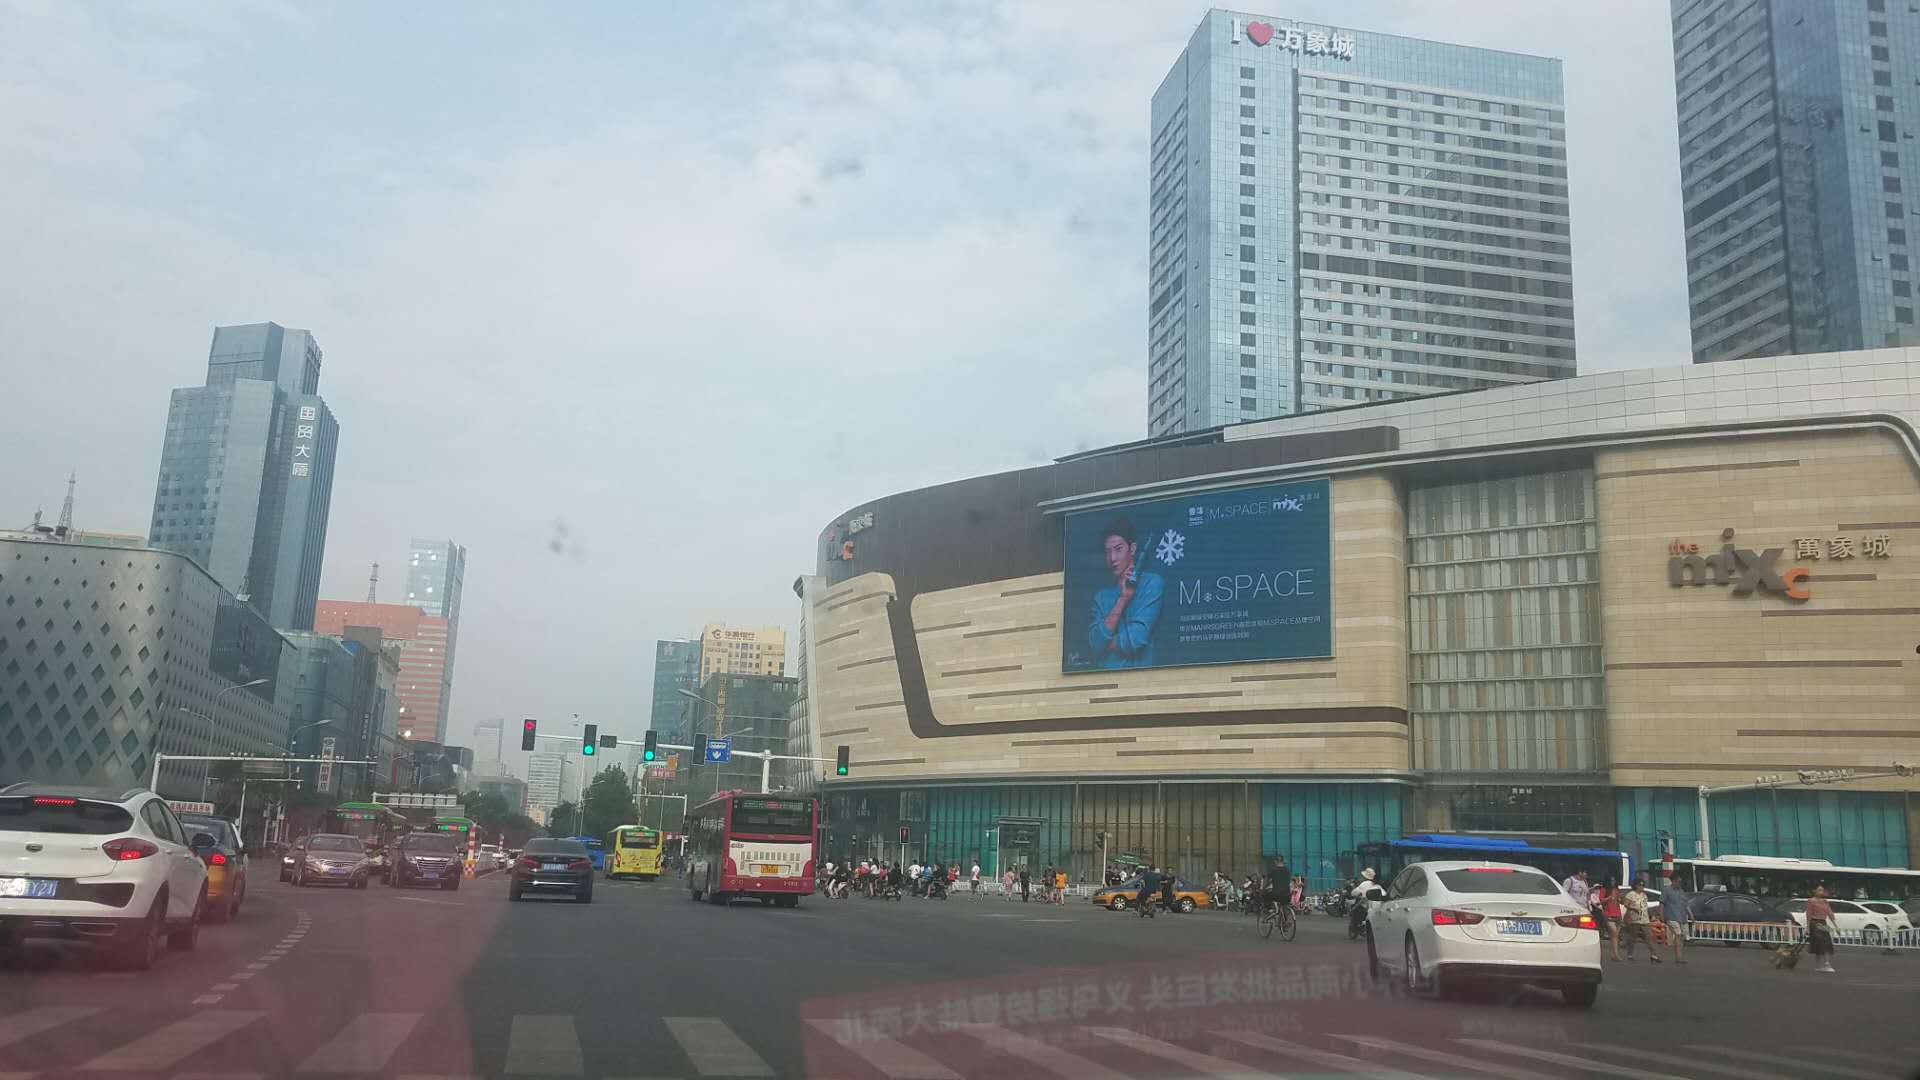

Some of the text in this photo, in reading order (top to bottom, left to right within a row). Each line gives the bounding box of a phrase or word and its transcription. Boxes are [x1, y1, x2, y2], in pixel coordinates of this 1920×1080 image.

[1278, 24, 1355, 58] 万象城
[292, 406, 316, 477] 国贸大厦
[1668, 537, 1698, 555] the
